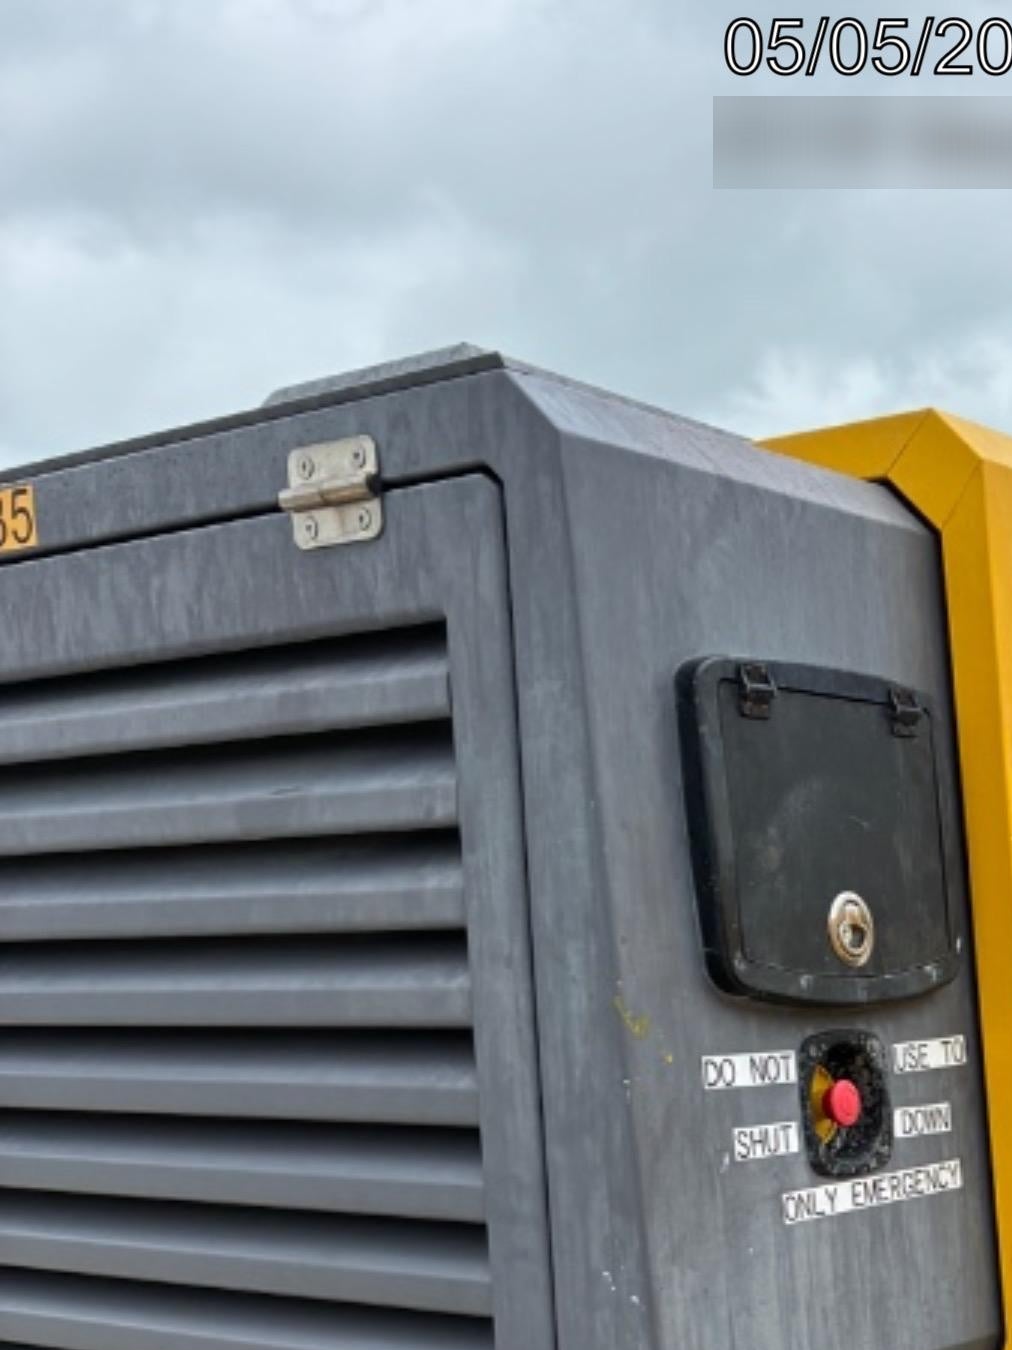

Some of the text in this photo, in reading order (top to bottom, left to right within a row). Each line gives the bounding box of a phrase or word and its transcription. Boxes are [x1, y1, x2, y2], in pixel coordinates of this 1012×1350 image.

[704, 1058, 736, 1088] DO
[750, 1054, 794, 1083] NOT
[942, 1038, 966, 1064] TO
[735, 1104, 950, 1160] SHUT DOWN
[783, 1164, 962, 1222] ONLY EMERGENCY
